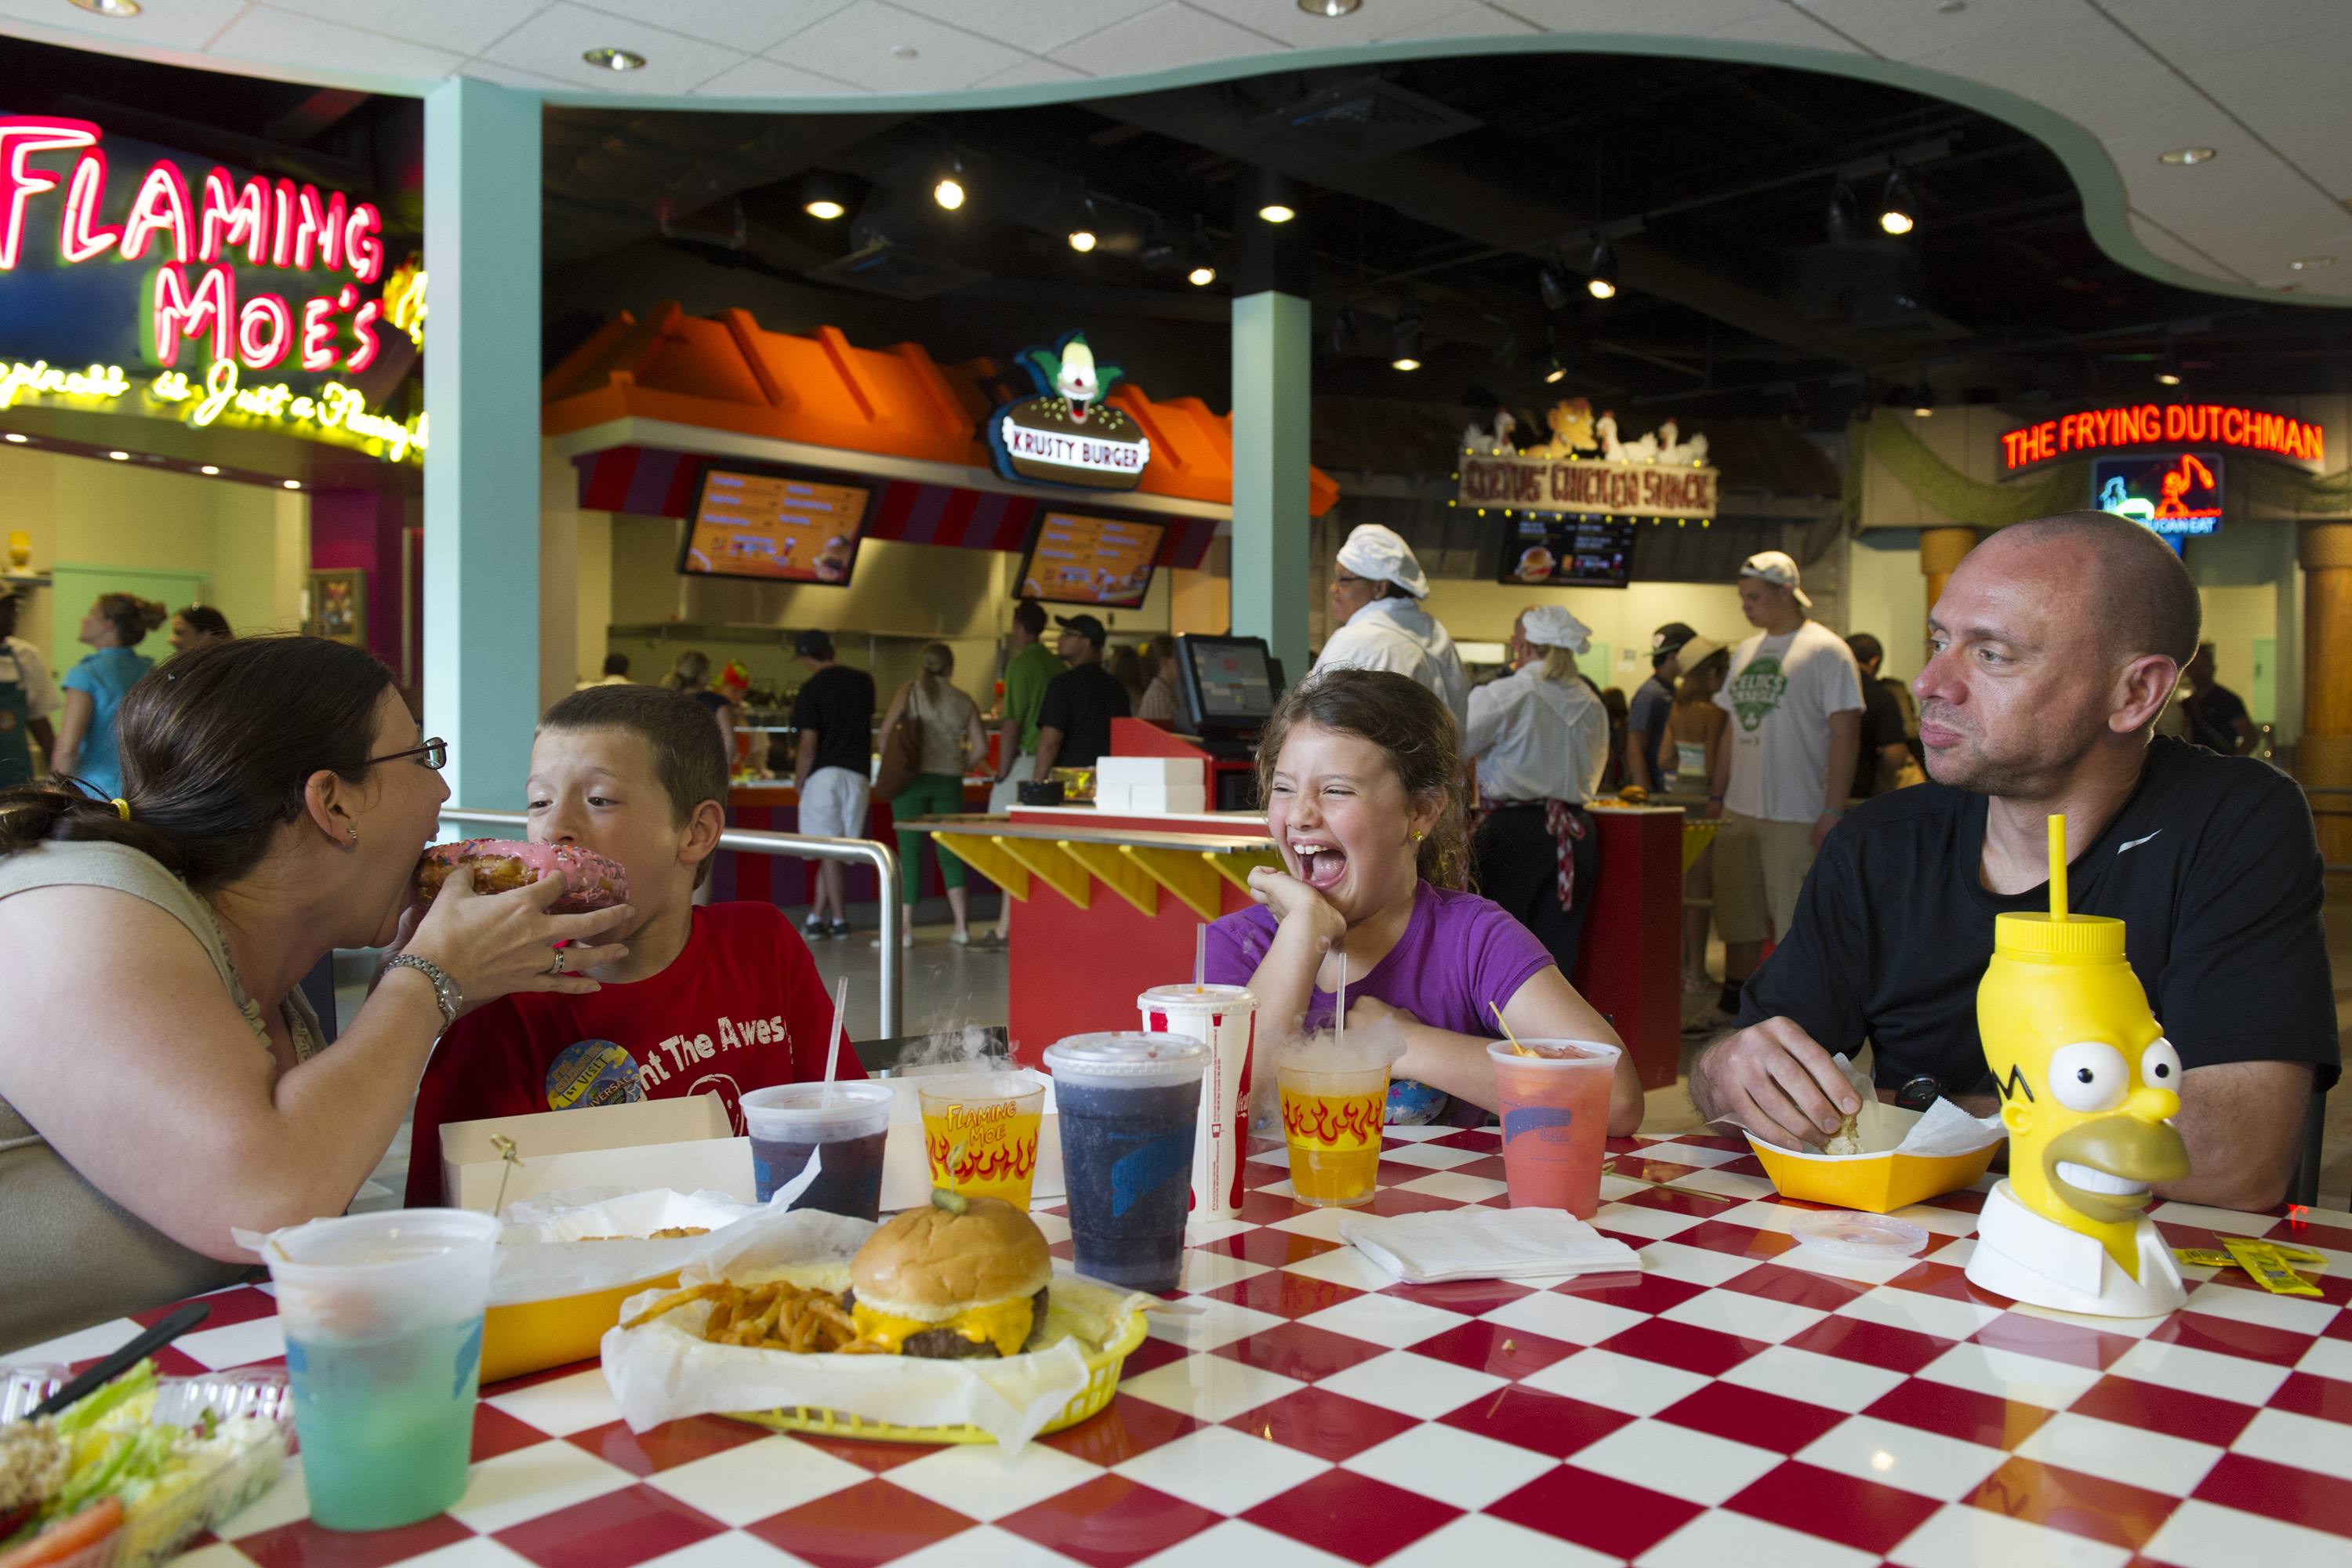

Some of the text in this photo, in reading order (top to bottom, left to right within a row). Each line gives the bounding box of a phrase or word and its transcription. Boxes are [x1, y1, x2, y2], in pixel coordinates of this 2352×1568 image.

[0, 115, 383, 284] FLAMING
[154, 260, 384, 374] MOE'S
[1013, 430, 1138, 468] KRUSTY BURGER
[2001, 404, 2325, 469] THE FRYING DUTCHMAN
[1551, 459, 1639, 510] CHICKEN
[1643, 469, 1712, 510] SHACK
[659, 1033, 717, 1073] The
[717, 1014, 790, 1052] Awes
[576, 1054, 609, 1085] VISIT
[946, 1101, 1017, 1132] FLAMING
[969, 1123, 1007, 1148] MOE
